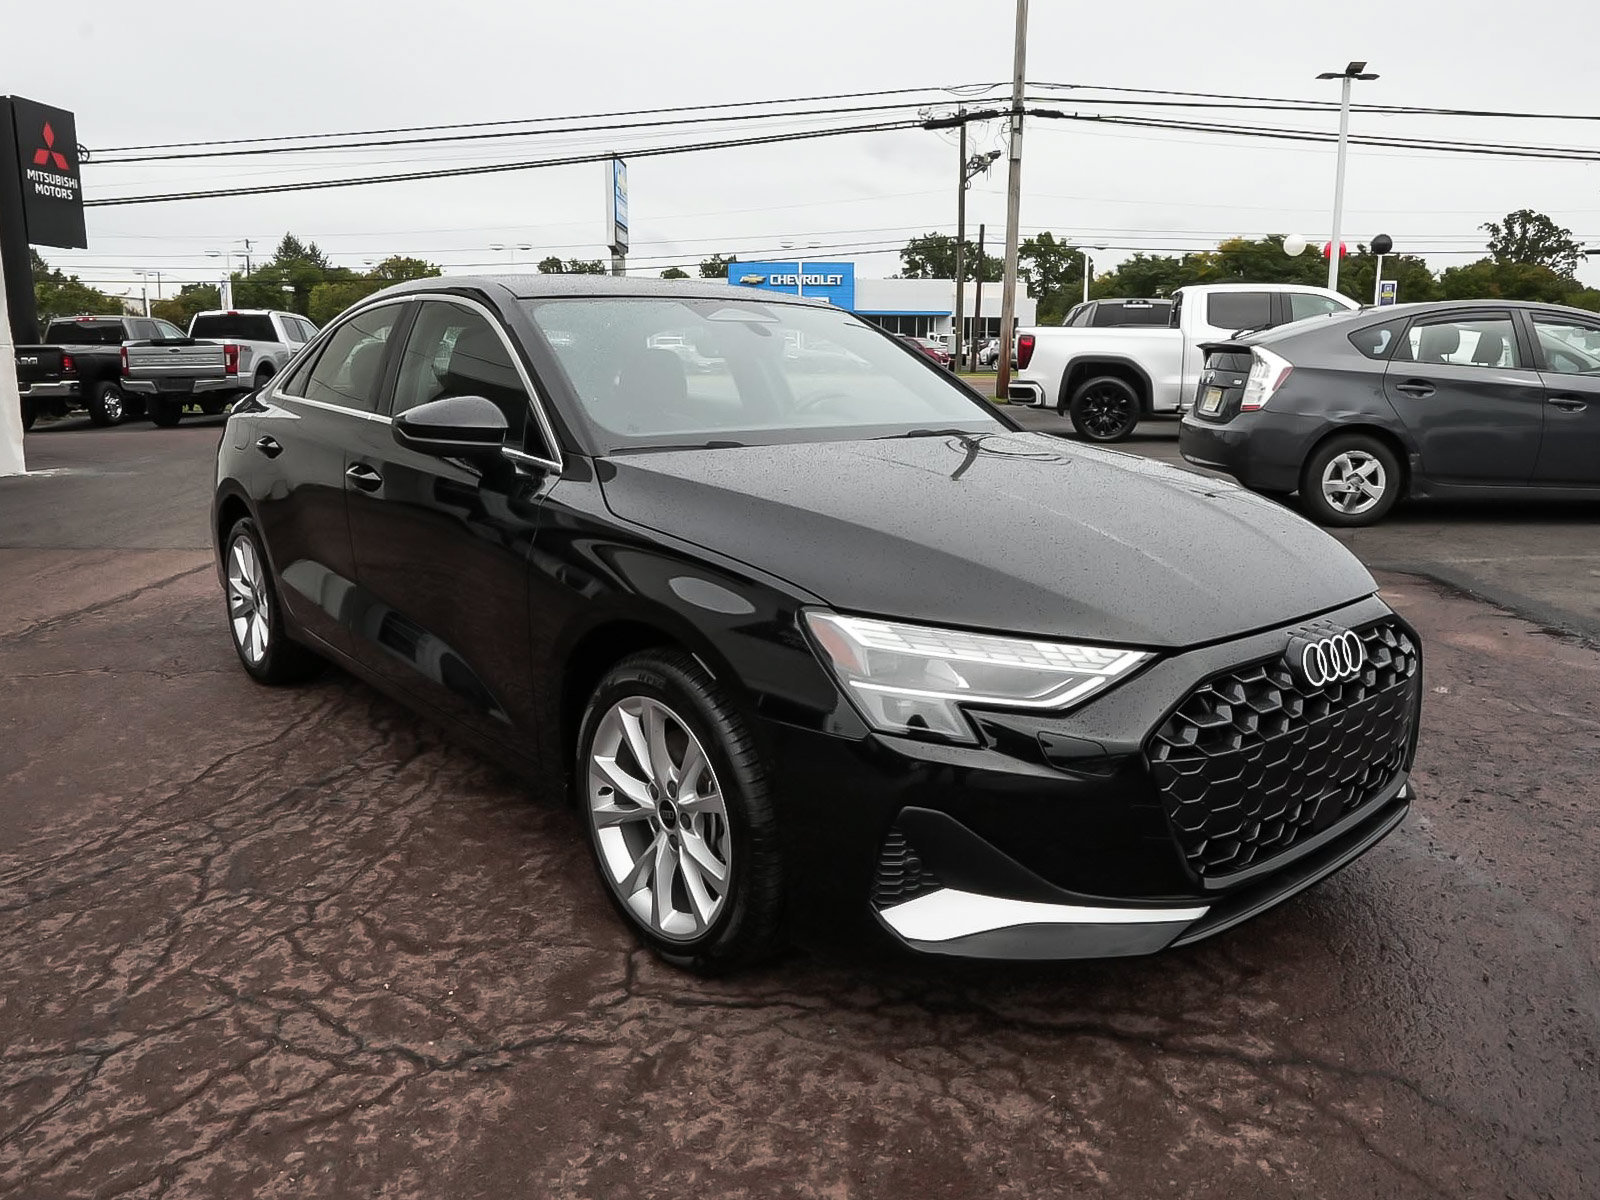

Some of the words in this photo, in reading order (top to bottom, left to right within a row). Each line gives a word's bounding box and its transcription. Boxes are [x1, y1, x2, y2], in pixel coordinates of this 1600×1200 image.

[26, 168, 78, 189] MITSUBISHI
[34, 182, 73, 200] MOTORS
[769, 274, 843, 286] CHEVROLET
